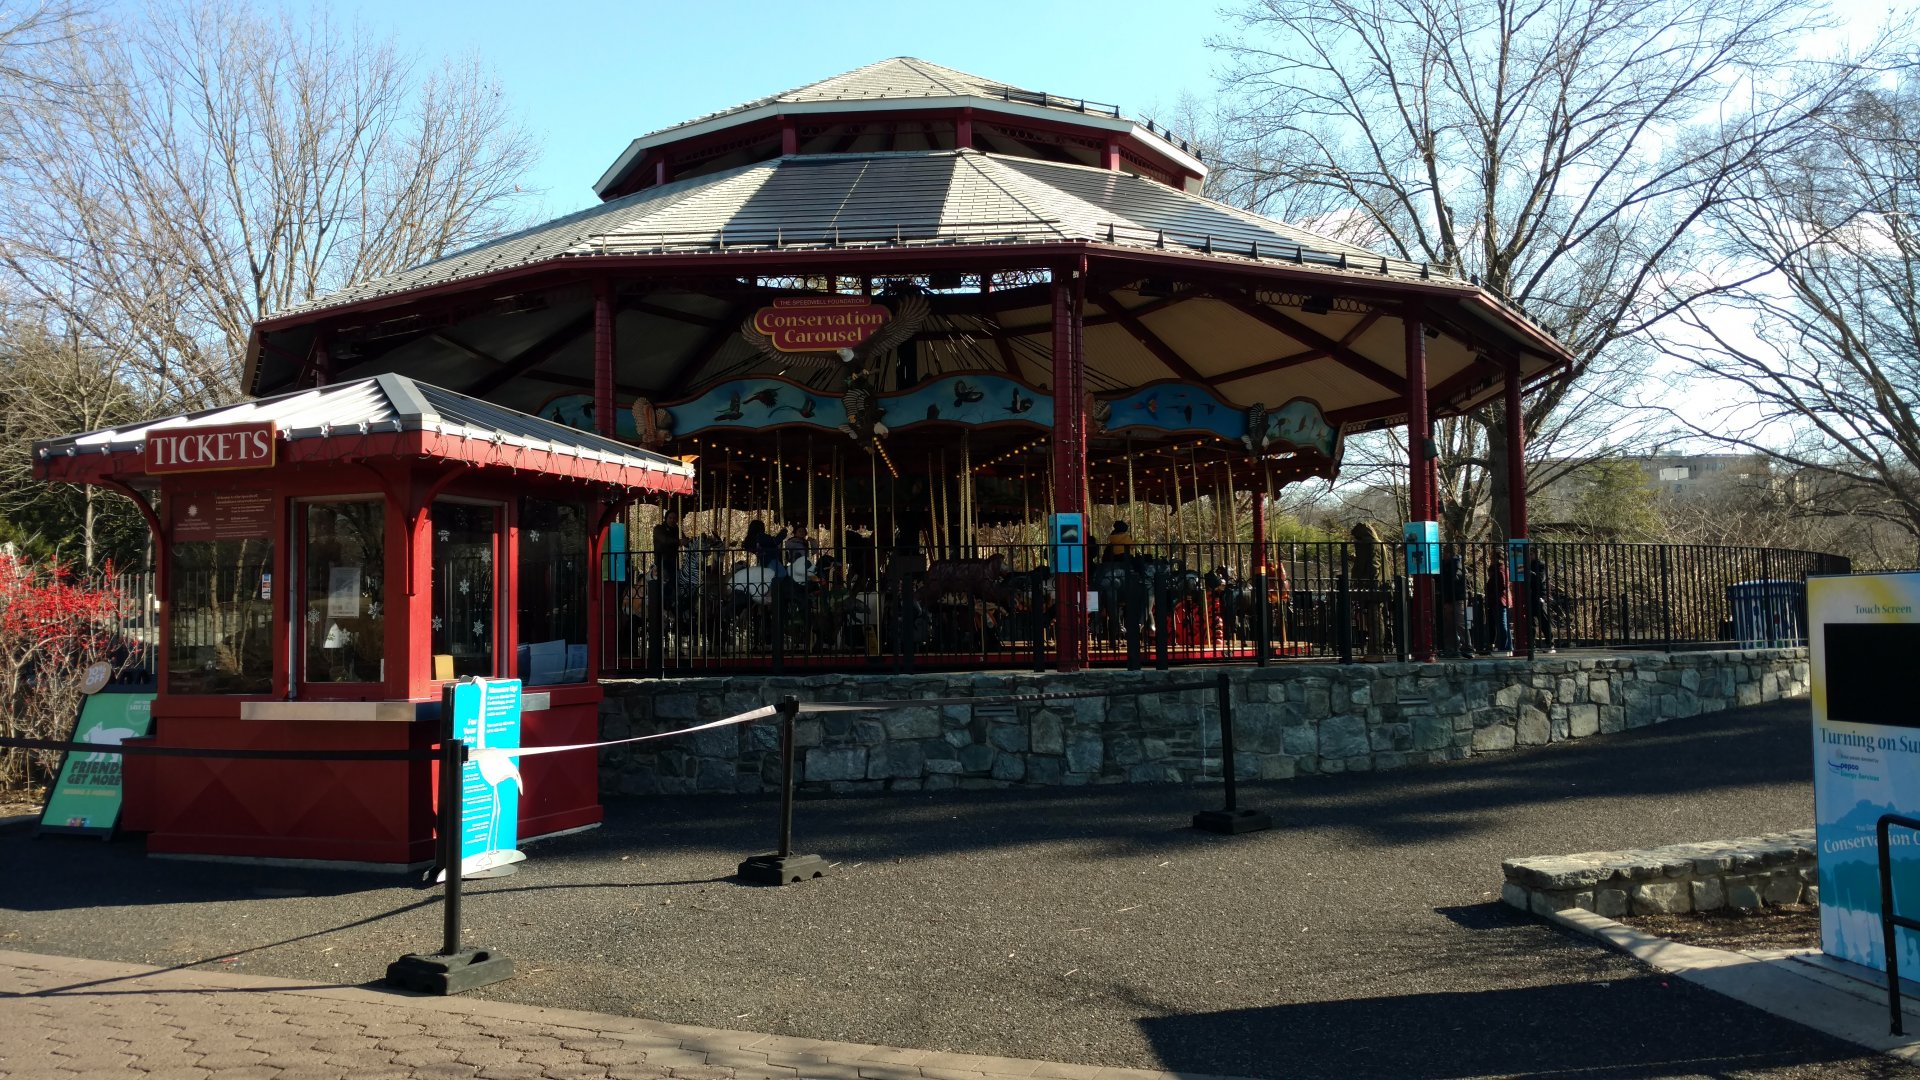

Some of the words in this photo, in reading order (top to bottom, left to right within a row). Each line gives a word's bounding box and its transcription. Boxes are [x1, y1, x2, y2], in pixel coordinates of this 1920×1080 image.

[763, 310, 883, 328] Conservation
[784, 327, 862, 343] Carousel
[150, 430, 268, 465] TICKETS
[1855, 603, 1880, 614] Touch
[1882, 604, 1912, 614] Screen
[85, 673, 106, 686] OFF
[1820, 727, 1875, 753] Turning
[1878, 737, 1896, 751] on
[1899, 735, 1920, 754] Su
[1840, 762, 1859, 771] pepco
[67, 773, 89, 785] GET
[89, 774, 122, 786] MORE
[1858, 772, 1880, 782] Services
[1824, 831, 1911, 853] Conservion
